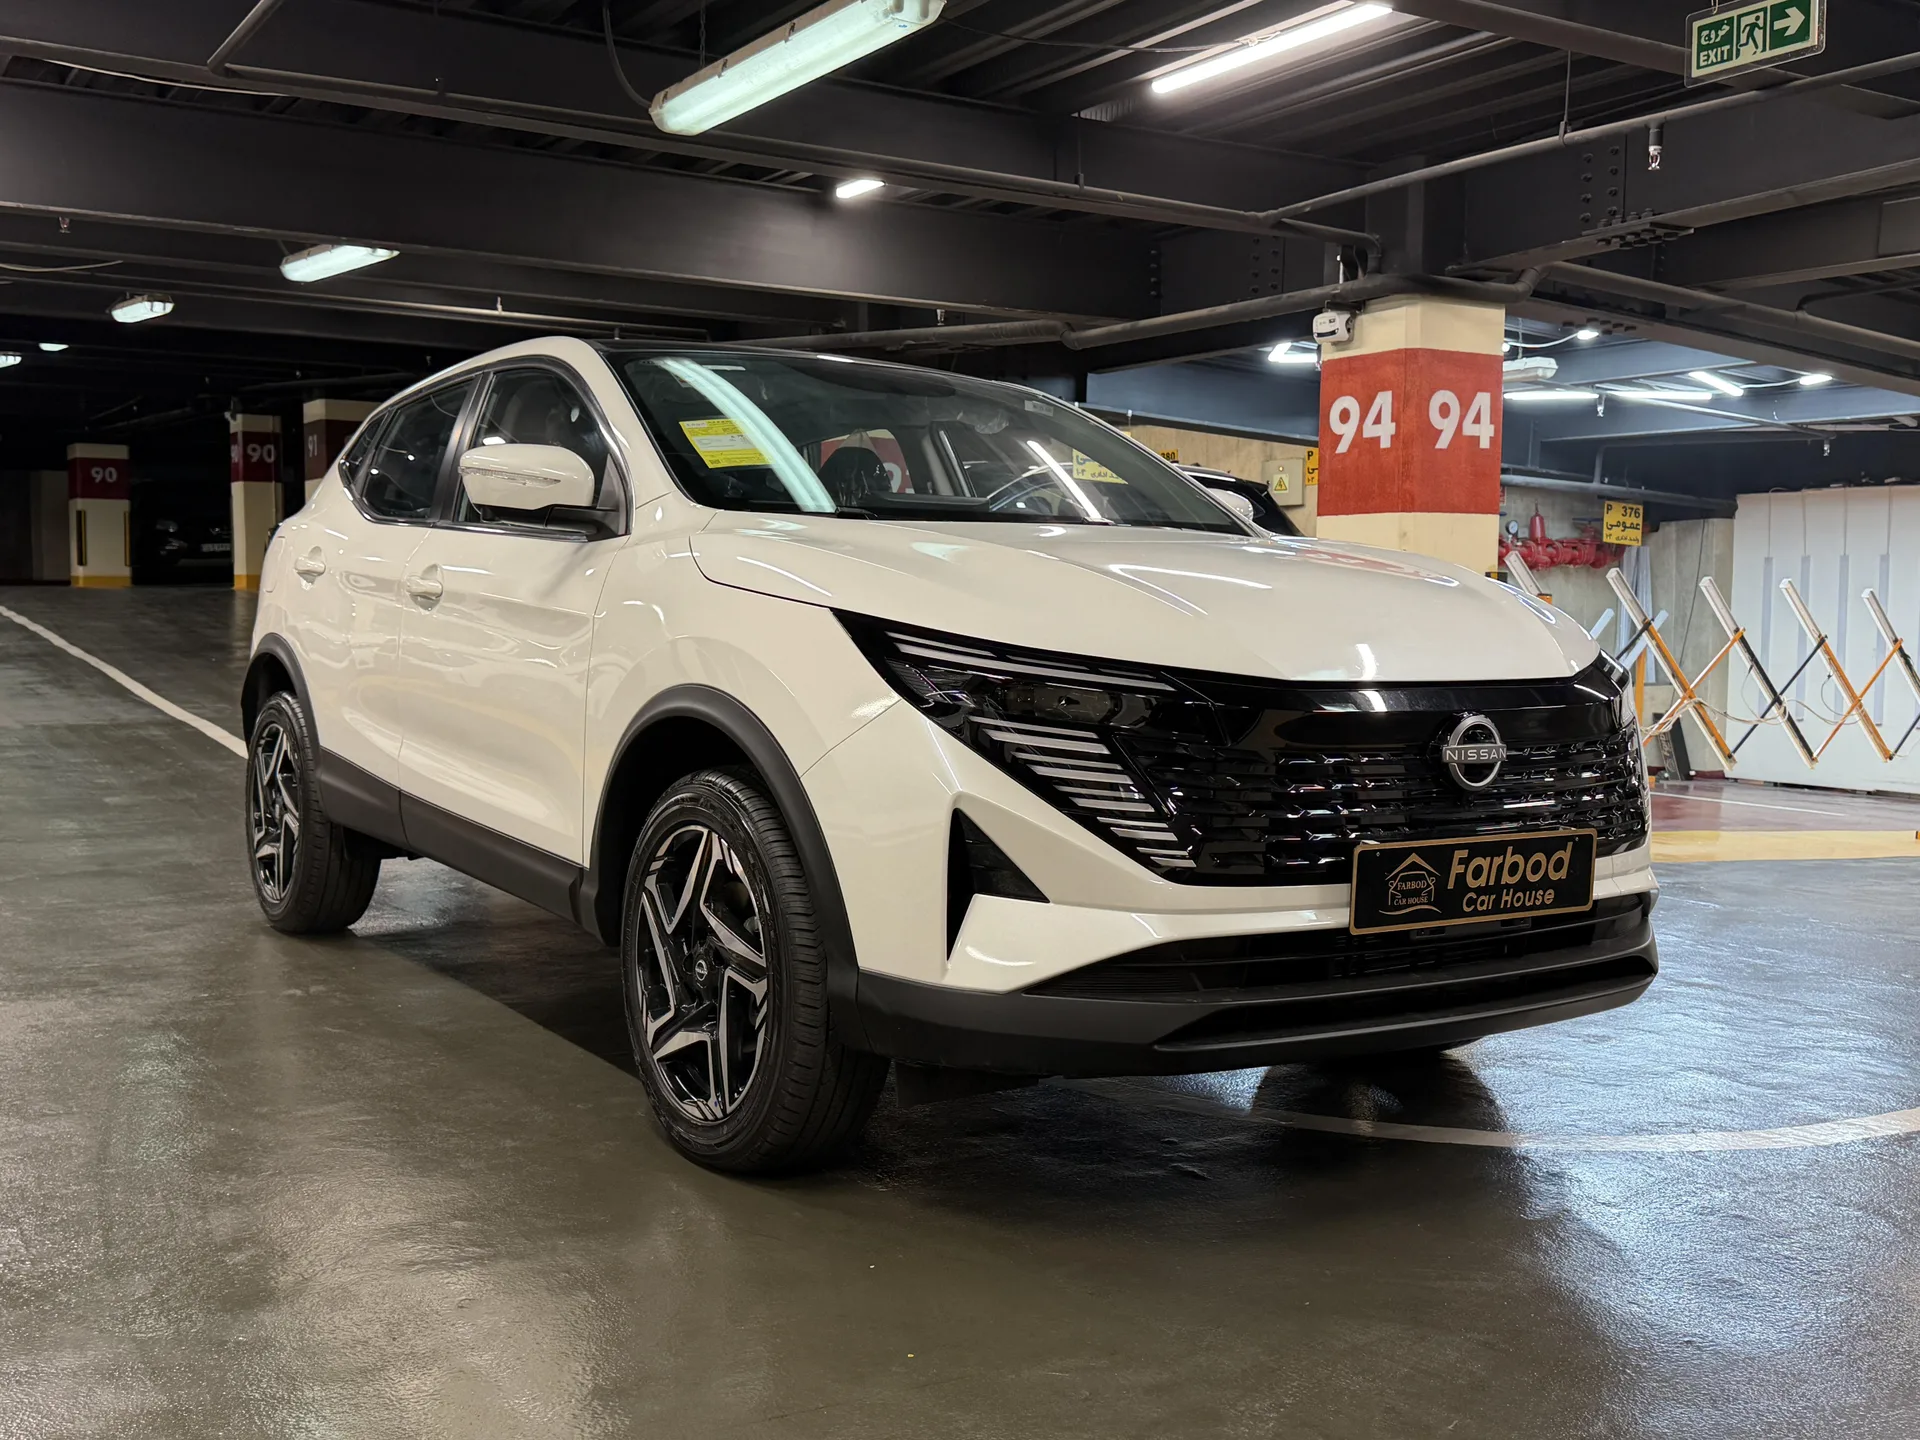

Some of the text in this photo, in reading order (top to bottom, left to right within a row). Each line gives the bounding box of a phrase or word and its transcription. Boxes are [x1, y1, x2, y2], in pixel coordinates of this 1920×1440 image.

[1700, 20, 1730, 45] خروج
[1700, 45, 1730, 66] EXIT
[1329, 390, 1396, 454] 94
[1428, 389, 1495, 449] 94
[246, 443, 275, 463] 90
[308, 434, 318, 458] 91
[1307, 450, 1314, 460] P
[91, 466, 118, 483] 90
[1606, 504, 1641, 519] P 376
[1606, 520, 1641, 532] عمومی
[1446, 747, 1507, 760] NISSAN
[1447, 841, 1573, 889] Farbod
[1397, 880, 1427, 890] FARBOD
[1393, 896, 1429, 906] CAR HOUSE
[1462, 888, 1555, 912] Car House
